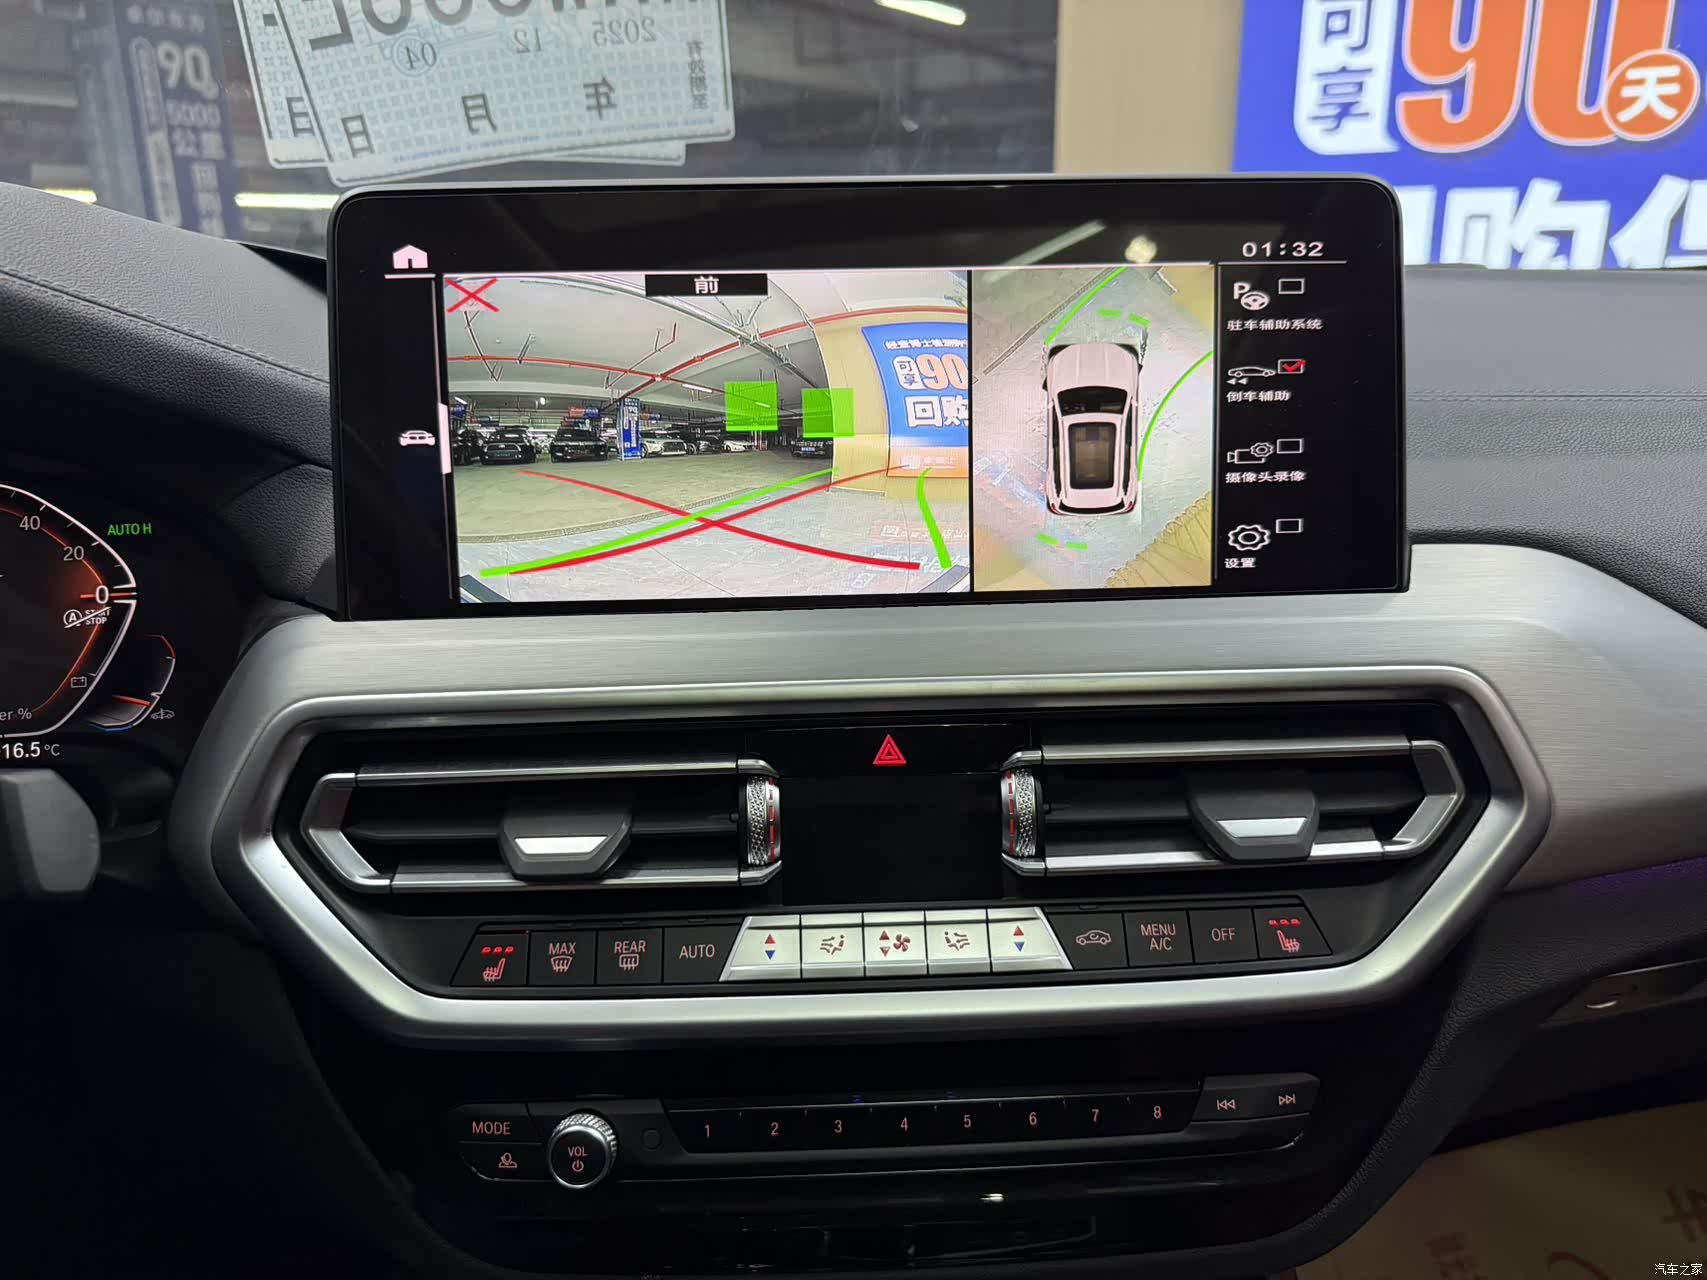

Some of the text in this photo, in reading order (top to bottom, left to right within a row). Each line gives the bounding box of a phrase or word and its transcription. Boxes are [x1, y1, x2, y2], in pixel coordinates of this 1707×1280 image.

[1618, 66, 1681, 122] 天
[1242, 241, 1324, 258] 01:32
[694, 276, 719, 294] 前
[1227, 318, 1323, 332] 驻车辅助系统
[1226, 390, 1291, 402] 倒车辅助
[1225, 471, 1307, 484] 摄像头录像
[19, 516, 41, 531] 40
[108, 523, 152, 536] AUTO H
[63, 546, 84, 561] 20
[1224, 558, 1257, 569] 设置
[95, 585, 109, 604] 0
[1140, 923, 1176, 936] MENU
[1211, 928, 1236, 942] OFF
[549, 942, 576, 955] MAX
[614, 940, 646, 953] REAR
[1150, 937, 1172, 951] A/C
[679, 944, 715, 959] AUTO
[472, 1121, 511, 1135] MODE
[704, 1105, 1162, 1138] 1 2 3 4 5 6 7 8
[568, 1146, 588, 1157] VOL
